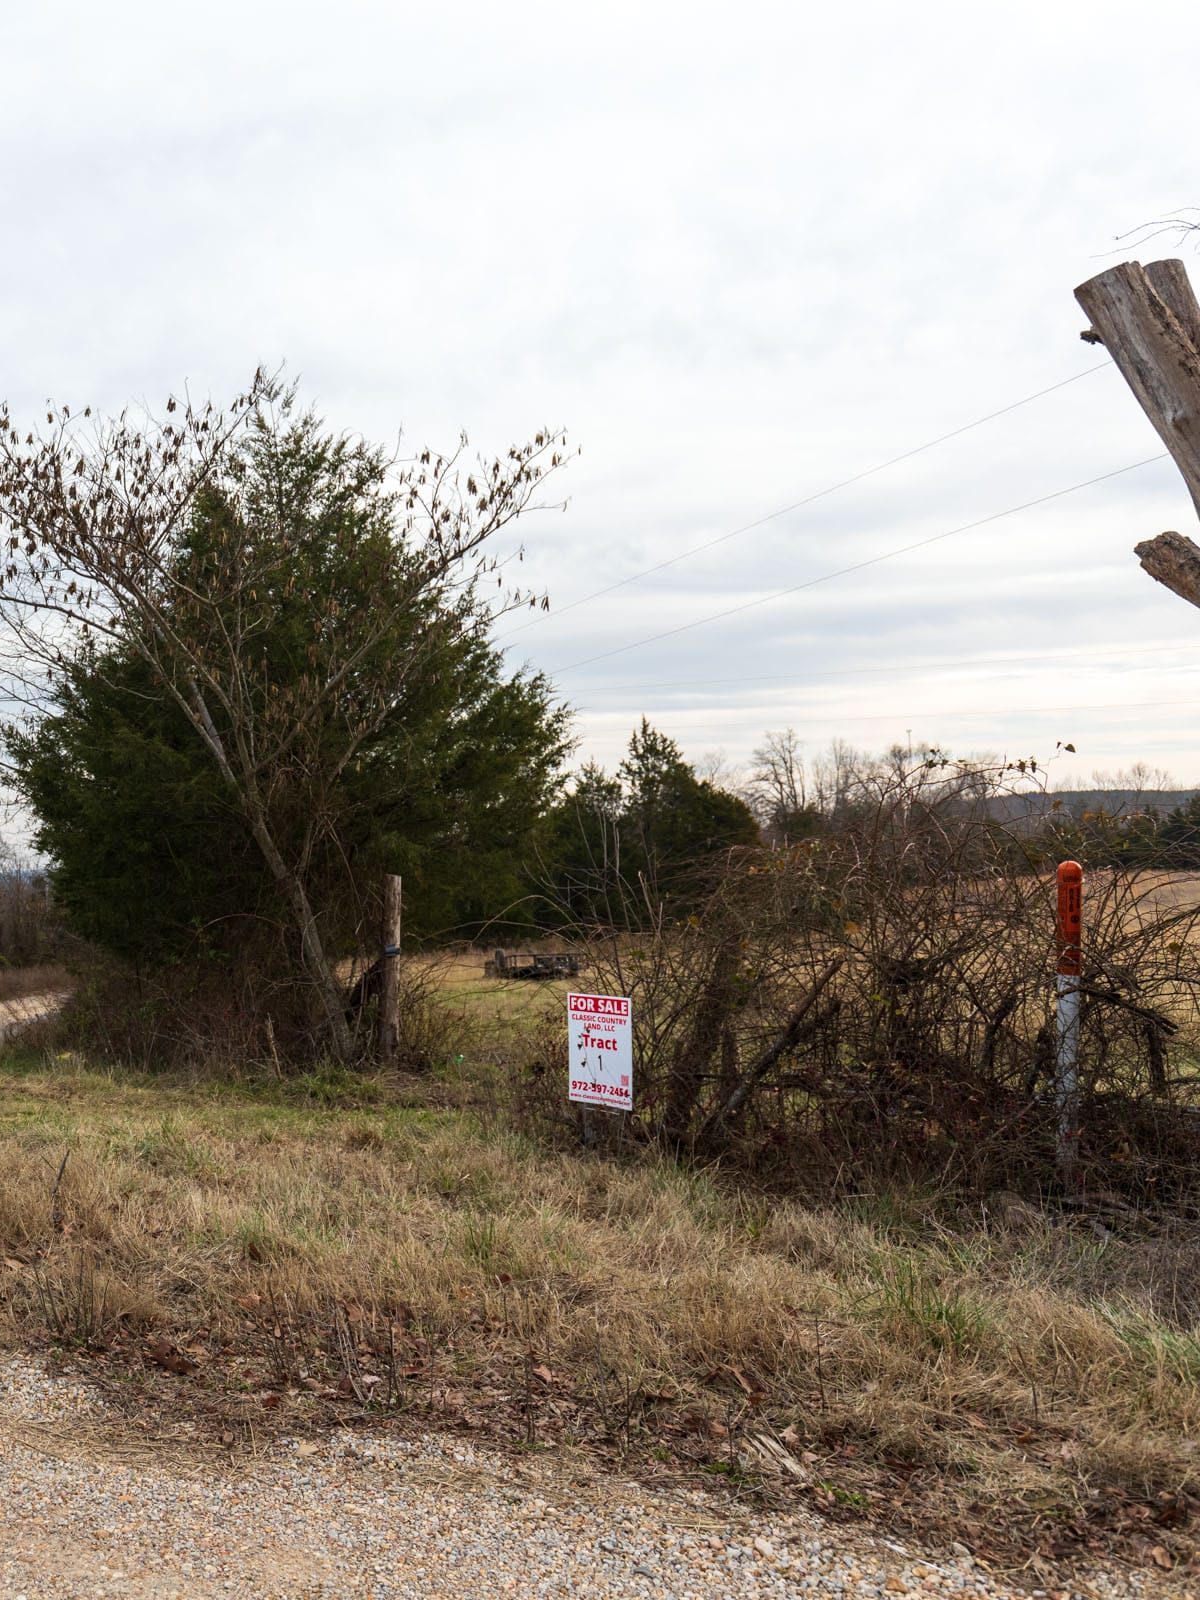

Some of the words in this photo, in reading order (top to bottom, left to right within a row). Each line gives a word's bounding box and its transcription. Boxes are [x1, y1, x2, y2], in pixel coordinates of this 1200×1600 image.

[571, 997, 595, 1011] FOR
[598, 1000, 628, 1015] SALE
[572, 1014, 596, 1022] CLASSIC
[598, 1016, 627, 1025] COUNTRY
[604, 1024, 615, 1032] LLC
[582, 1033, 618, 1051] Tract
